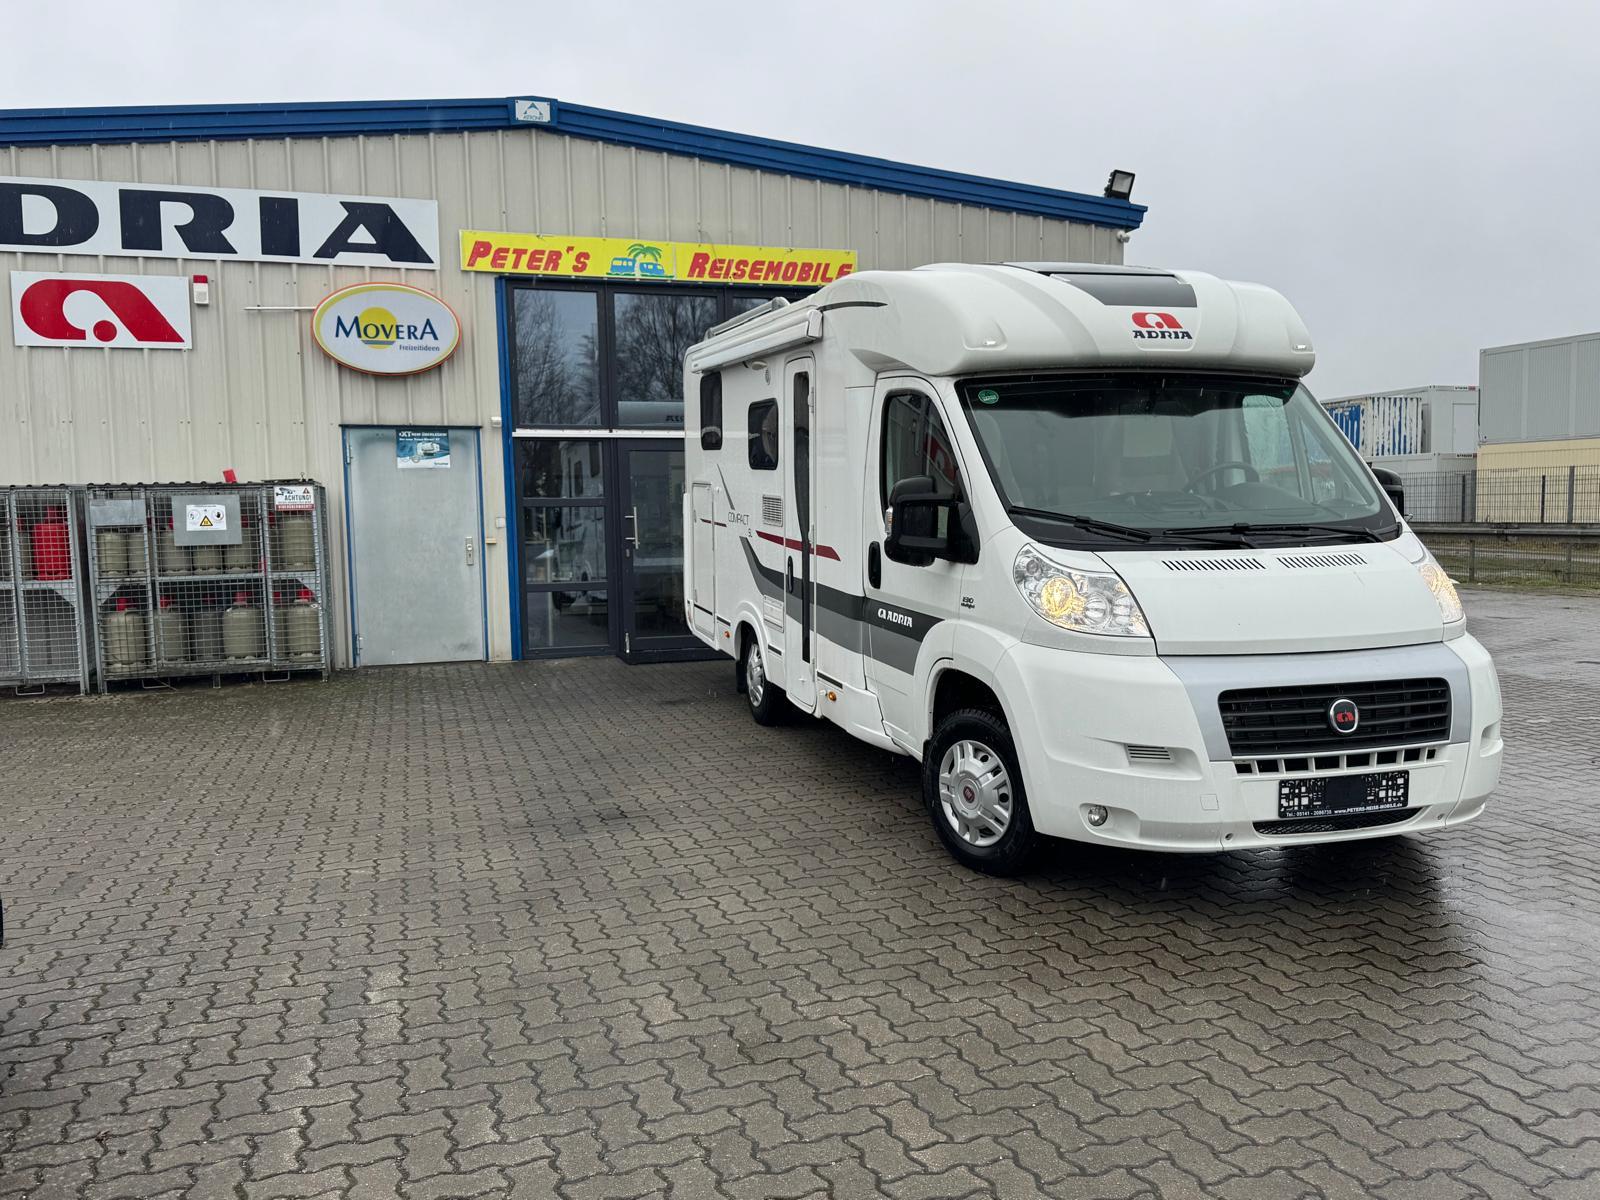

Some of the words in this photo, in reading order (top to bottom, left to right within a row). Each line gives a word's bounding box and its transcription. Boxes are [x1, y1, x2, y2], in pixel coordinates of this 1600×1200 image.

[1132, 330, 1193, 339] ADRIA
[399, 344, 440, 352] Freizeitideen
[887, 610, 913, 628] ADRIA
